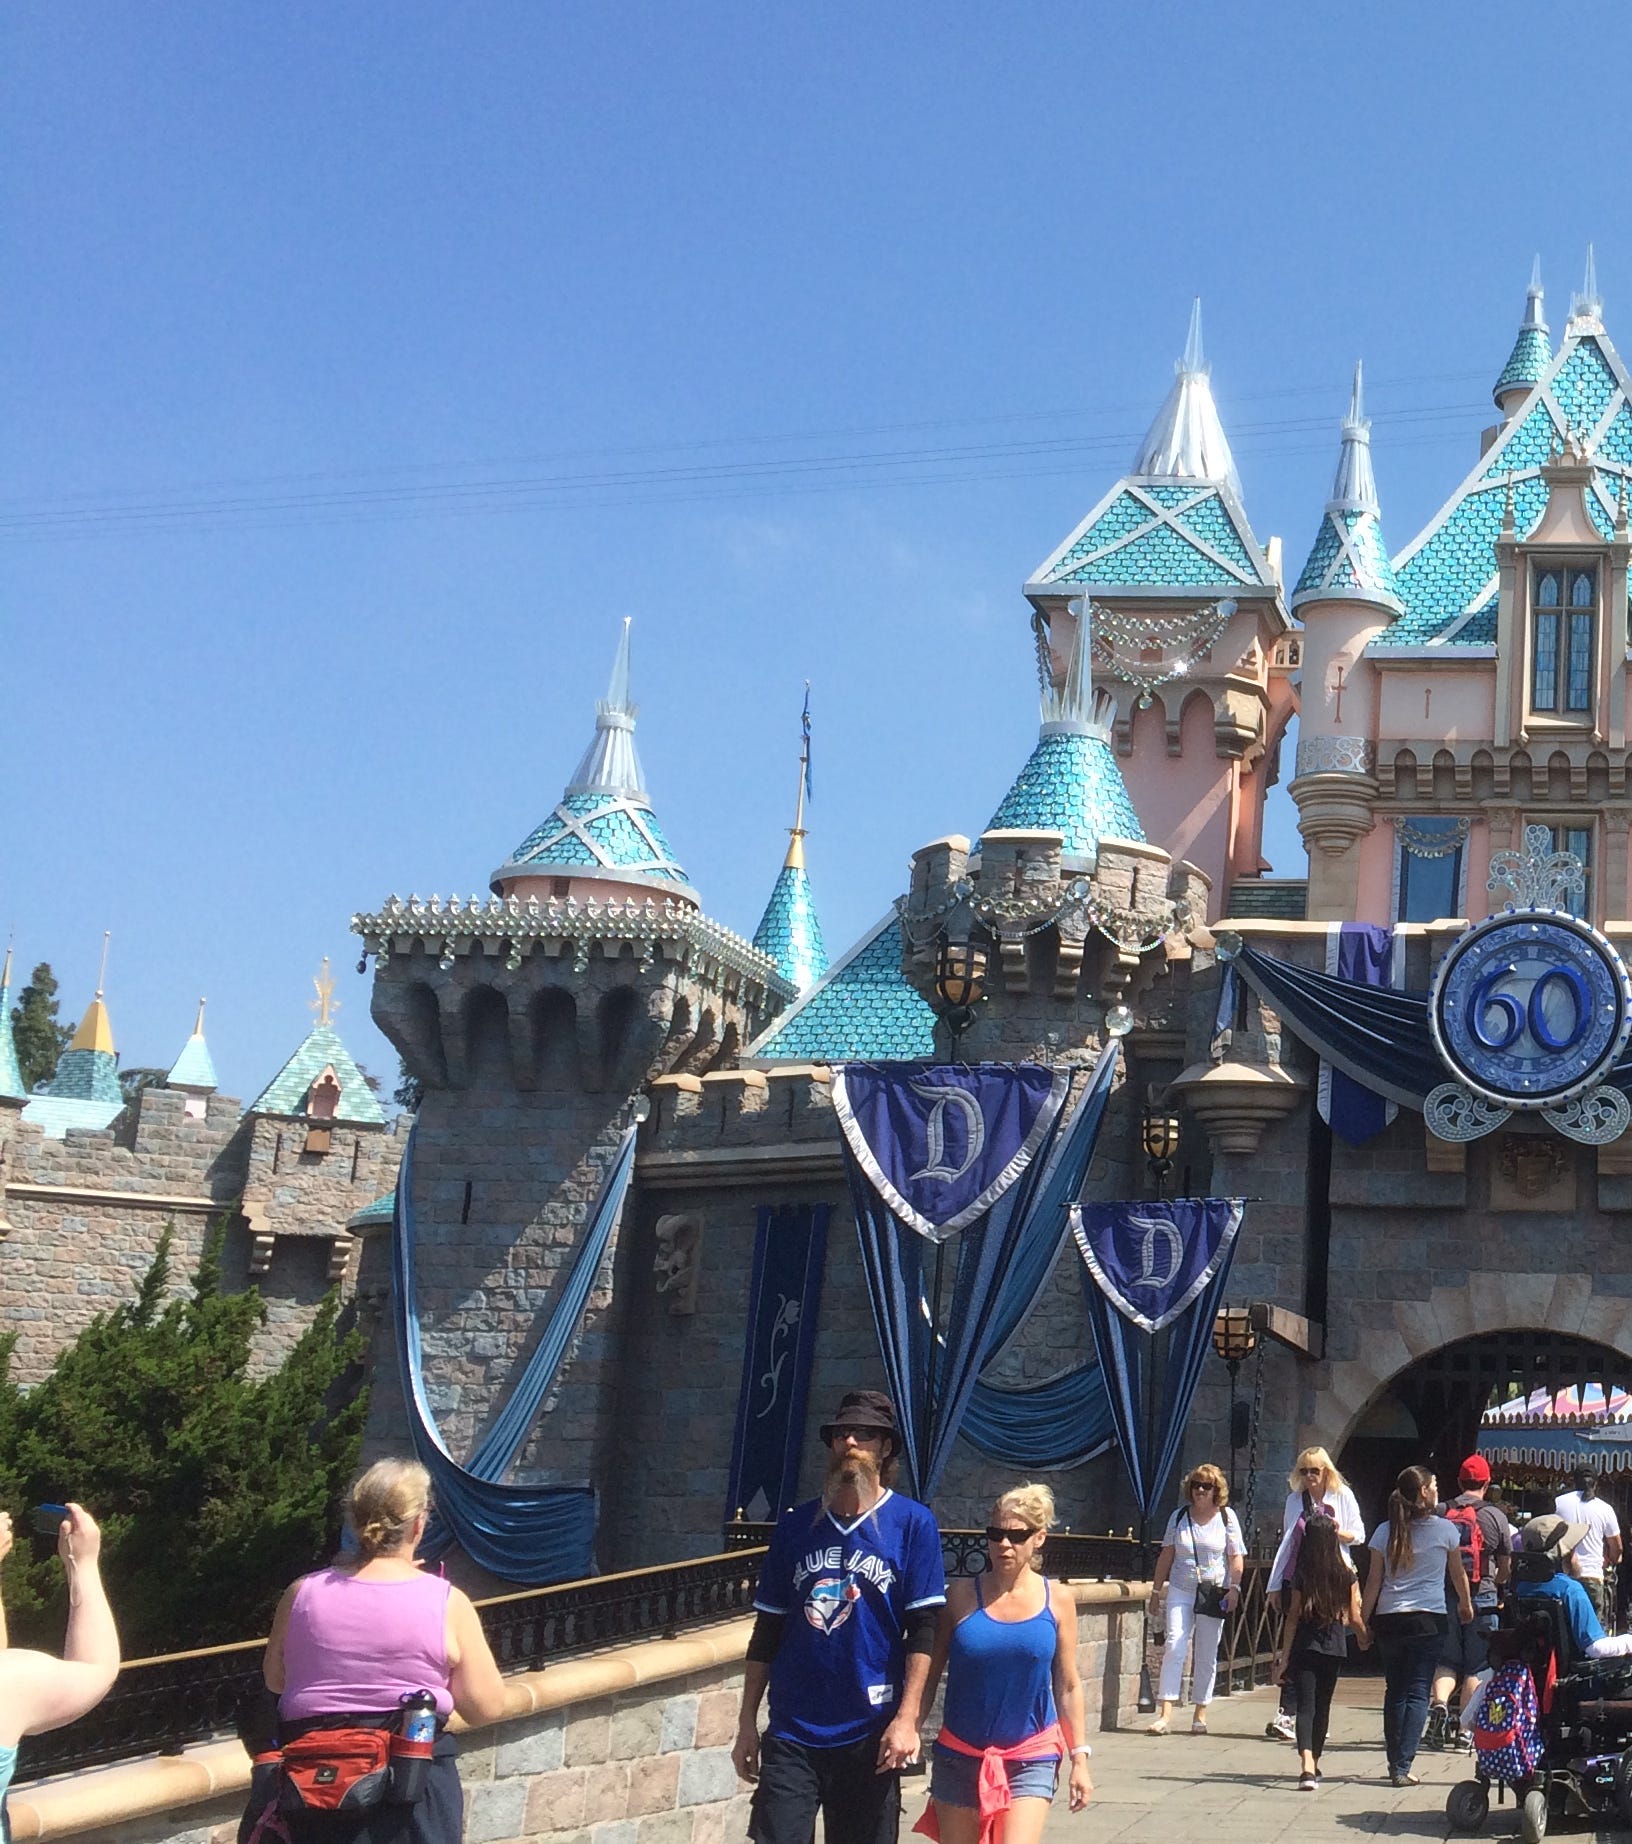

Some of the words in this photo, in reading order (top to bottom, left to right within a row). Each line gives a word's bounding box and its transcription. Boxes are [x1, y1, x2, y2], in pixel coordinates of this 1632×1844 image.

[1467, 964, 1592, 1053] 60
[909, 1081, 985, 1184] D
[1127, 1215, 1184, 1289] D
